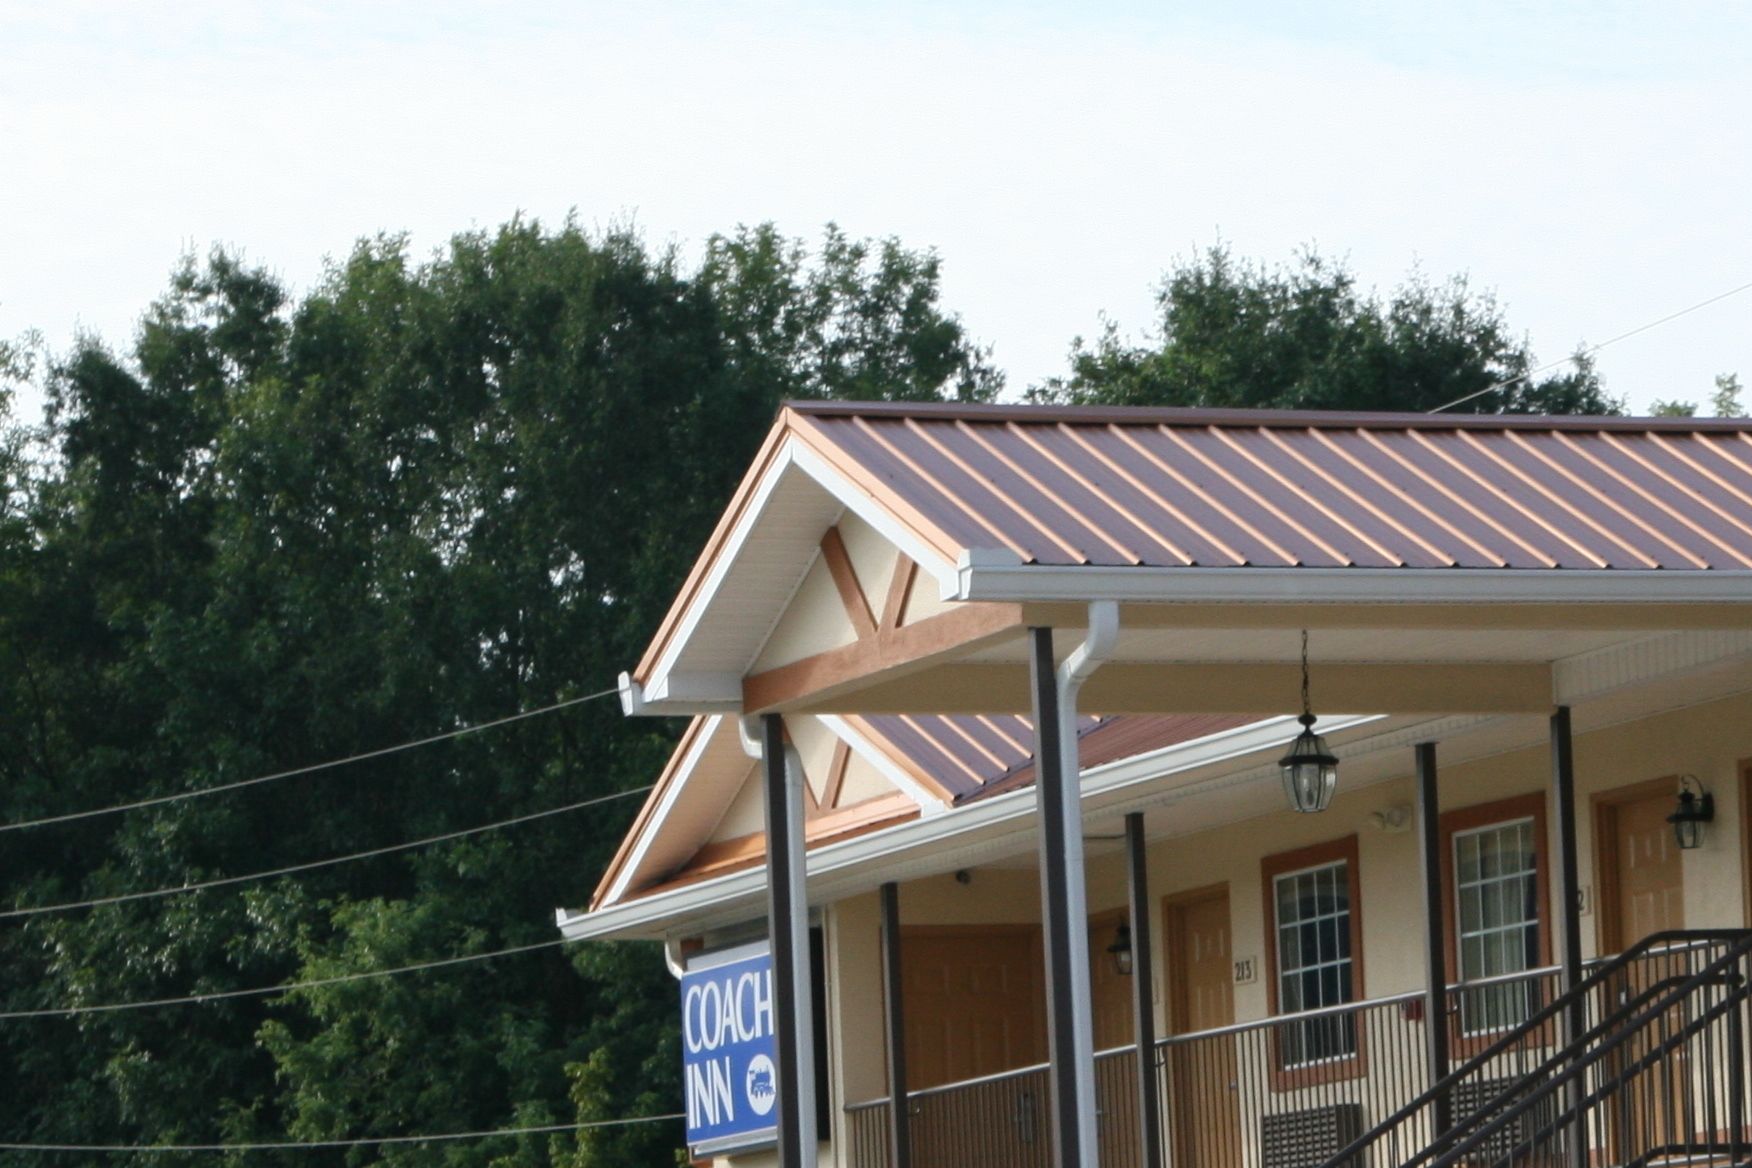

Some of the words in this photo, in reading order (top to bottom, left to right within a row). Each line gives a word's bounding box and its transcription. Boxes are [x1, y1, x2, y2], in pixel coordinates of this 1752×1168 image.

[1234, 961, 1252, 982] 213
[684, 969, 774, 1054] COACH
[687, 1056, 734, 1129] INN
